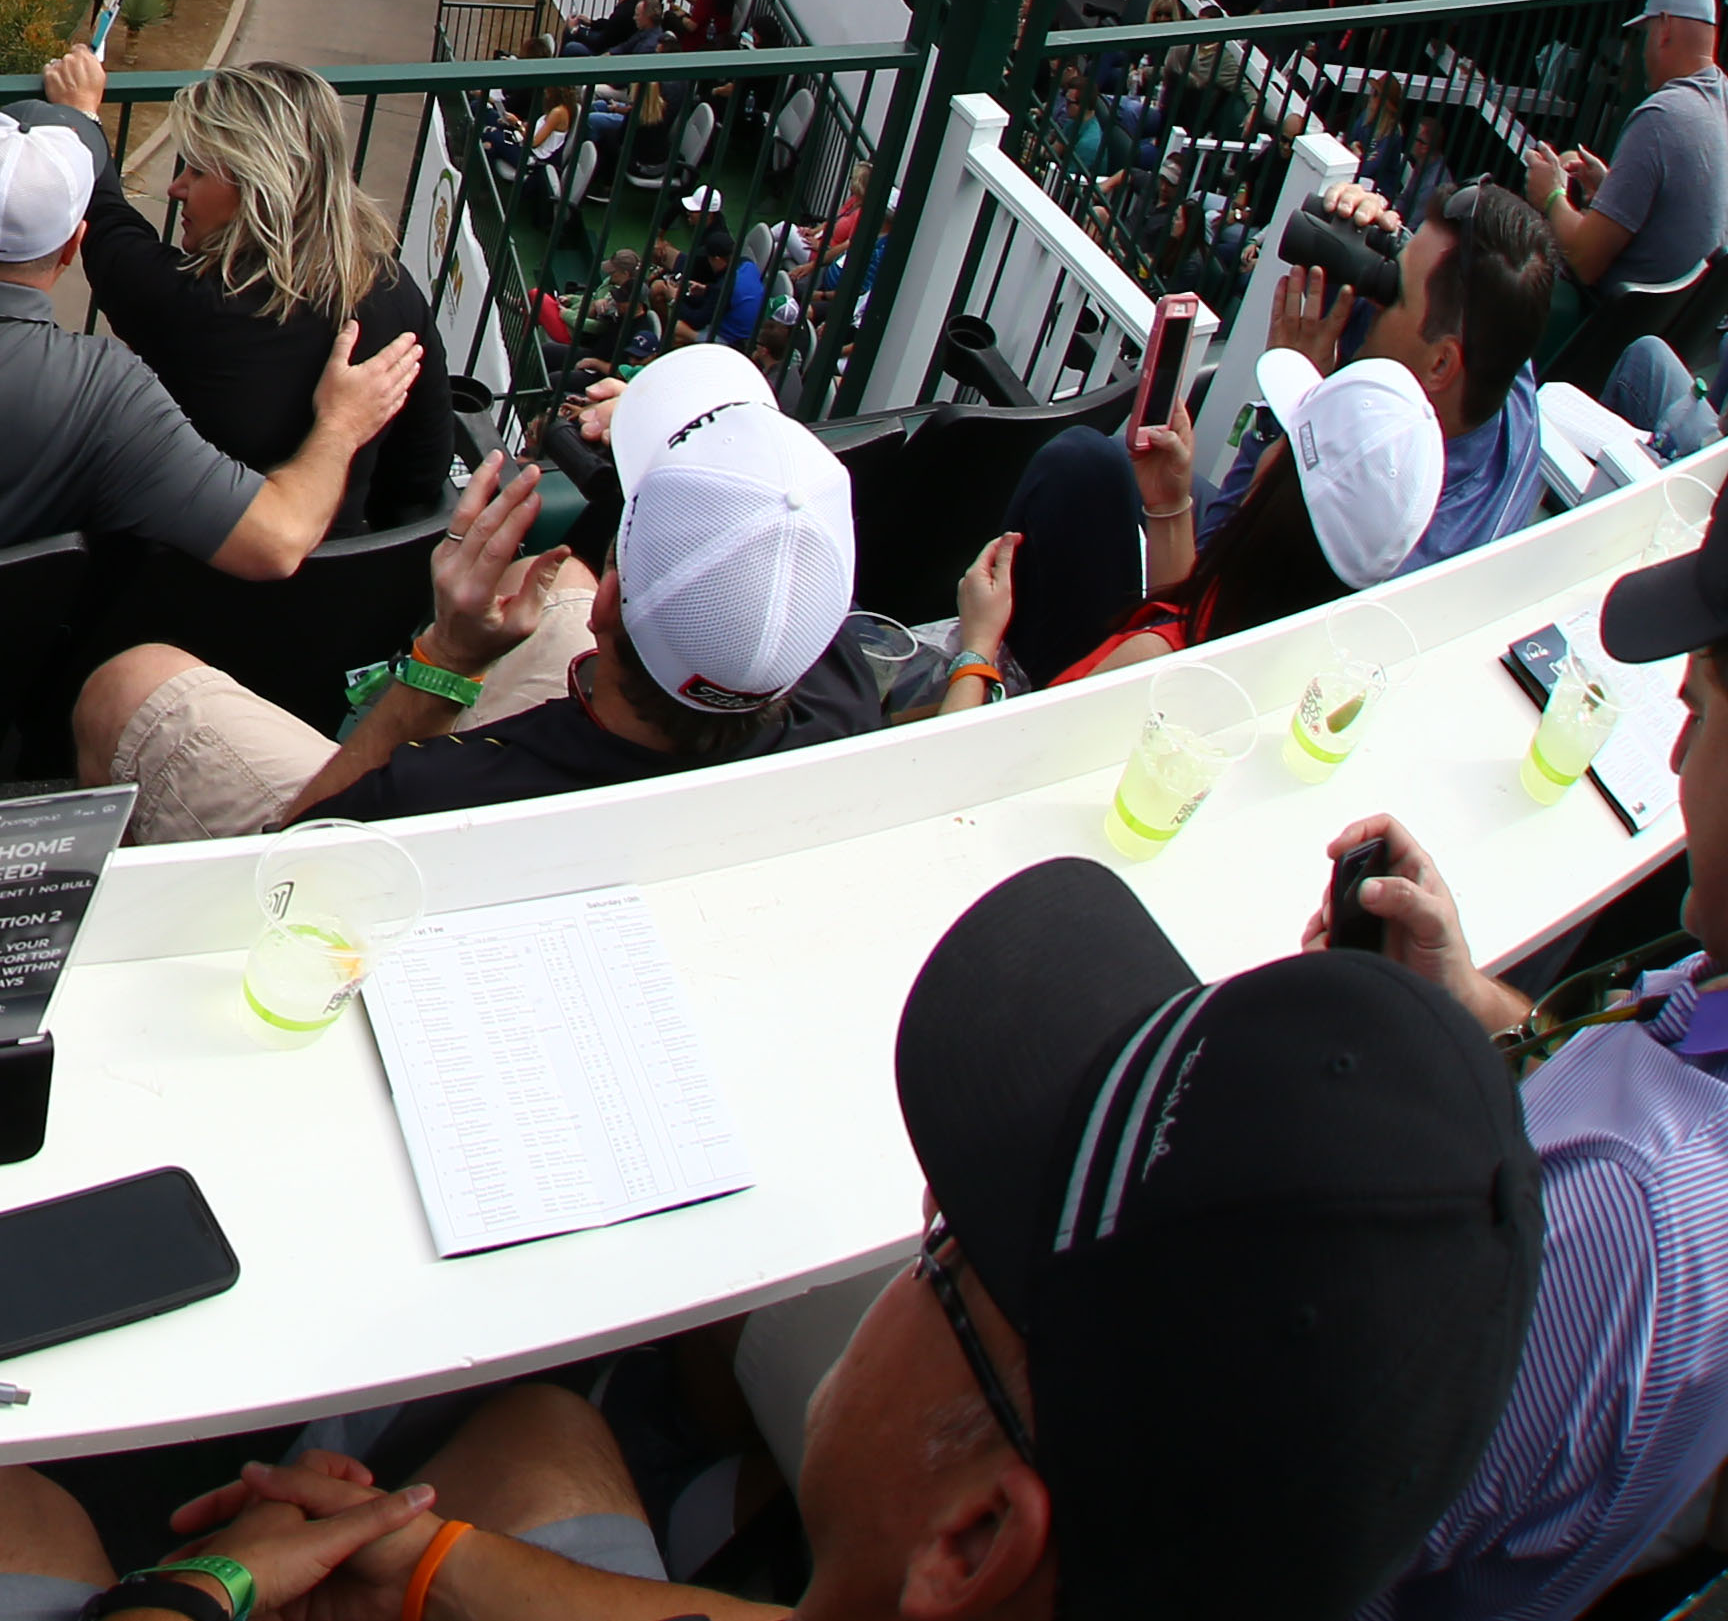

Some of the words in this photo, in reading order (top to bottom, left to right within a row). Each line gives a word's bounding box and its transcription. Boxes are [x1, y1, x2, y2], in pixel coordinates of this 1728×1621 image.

[38, 884, 59, 895] NO
[61, 879, 94, 891] BULL
[47, 910, 63, 923] 2
[6, 938, 50, 953] YOUR
[30, 948, 62, 962] TOP
[2, 960, 61, 976] WITHIN
